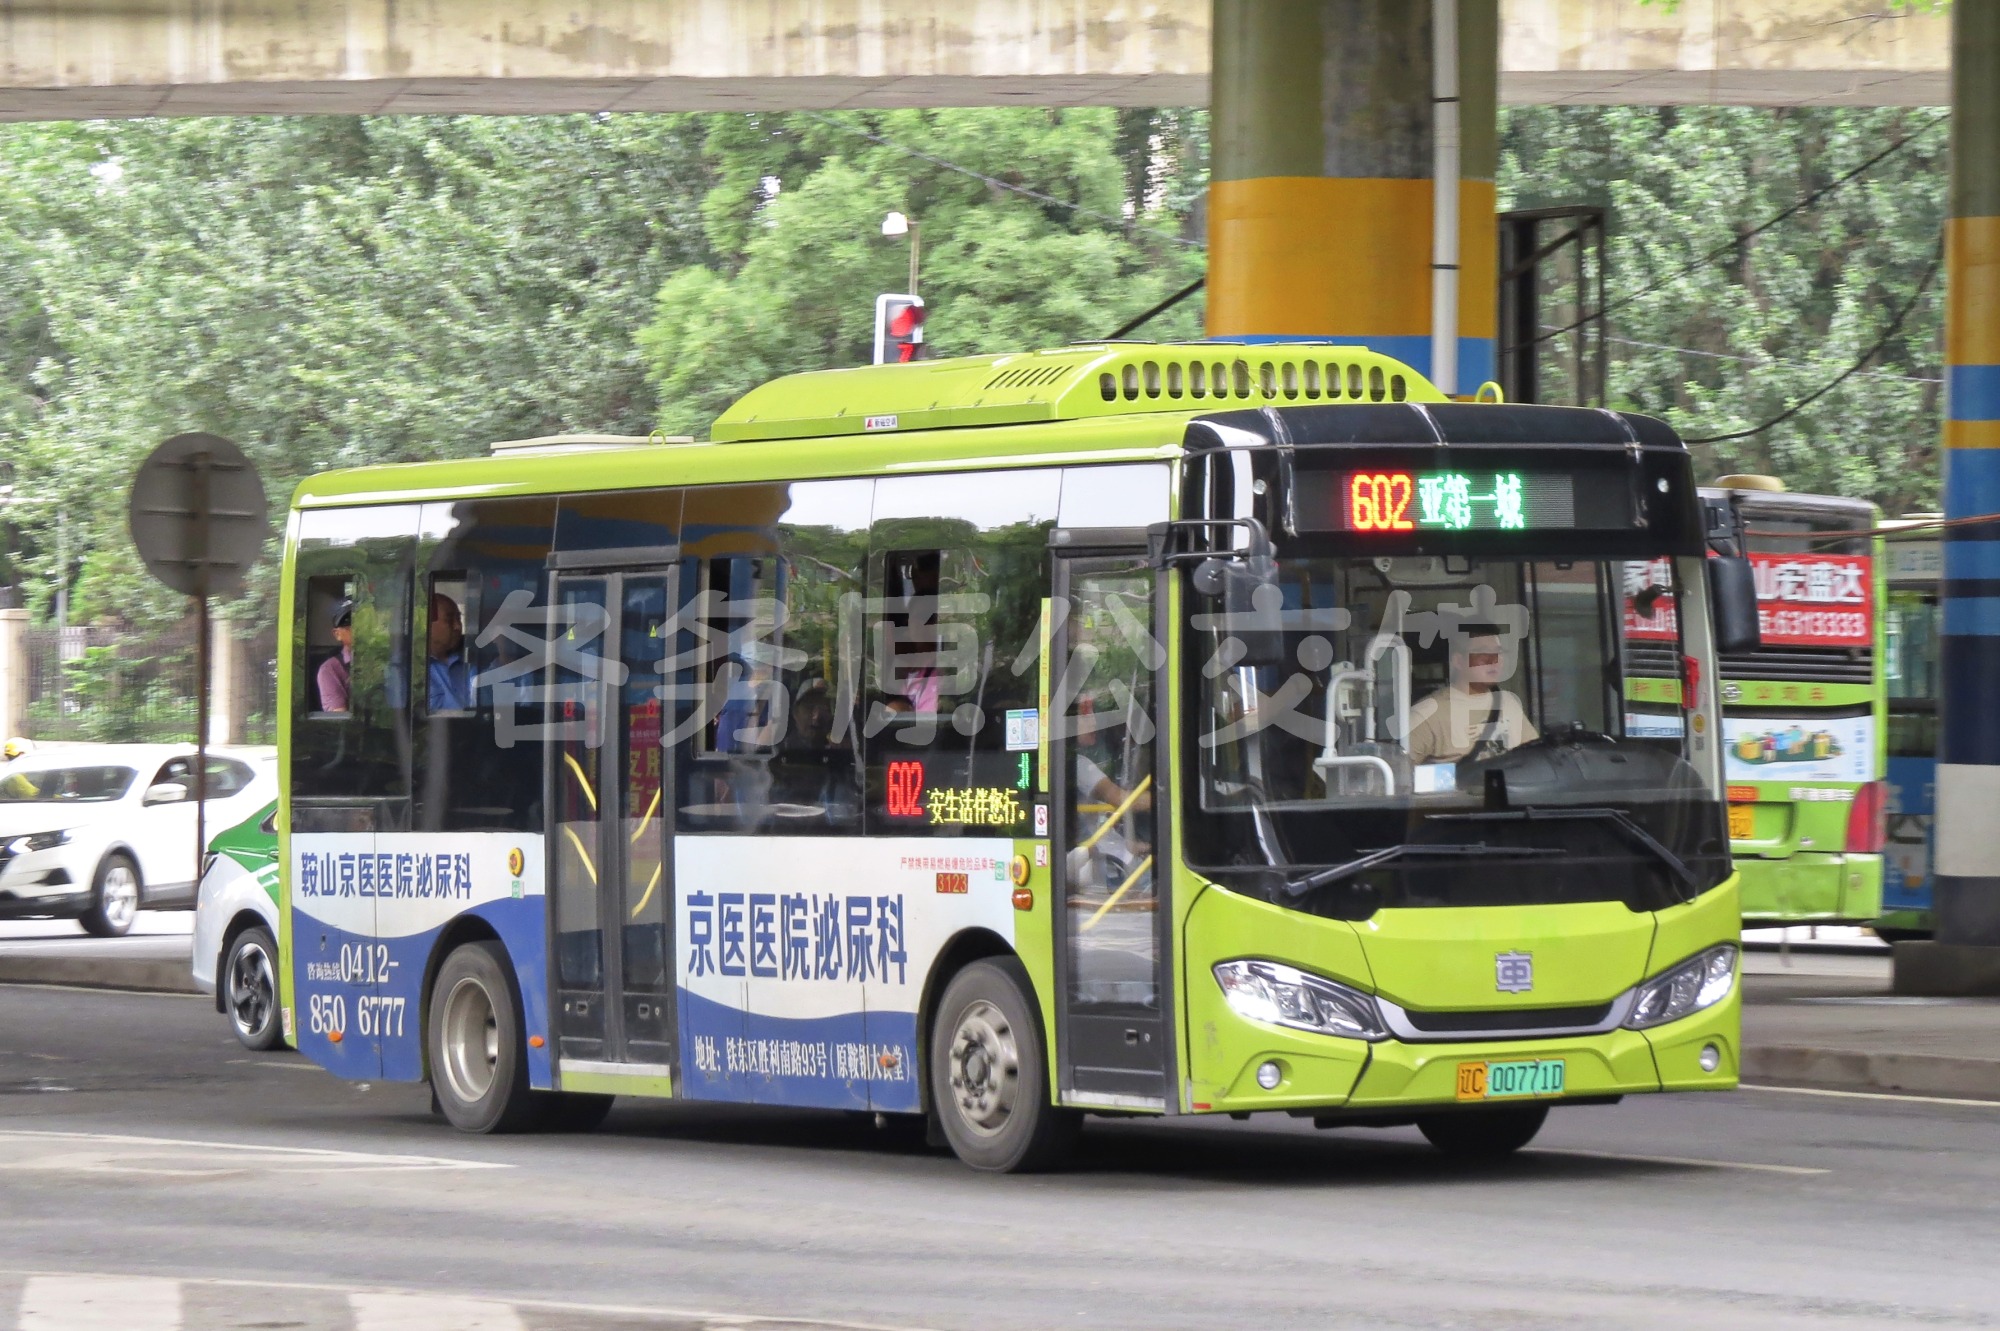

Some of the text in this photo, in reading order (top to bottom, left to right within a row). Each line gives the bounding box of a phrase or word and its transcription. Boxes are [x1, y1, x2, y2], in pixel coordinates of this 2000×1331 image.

[1351, 474, 1414, 530] 602
[887, 760, 925, 817] 602
[300, 851, 472, 900] 鞍山京医医院泌尿科
[937, 874, 968, 893] 3123
[687, 891, 908, 985] 京医医院泌尿科
[340, 943, 400, 983] 0412-
[310, 994, 347, 1034] 850
[358, 995, 406, 1037] 6777
